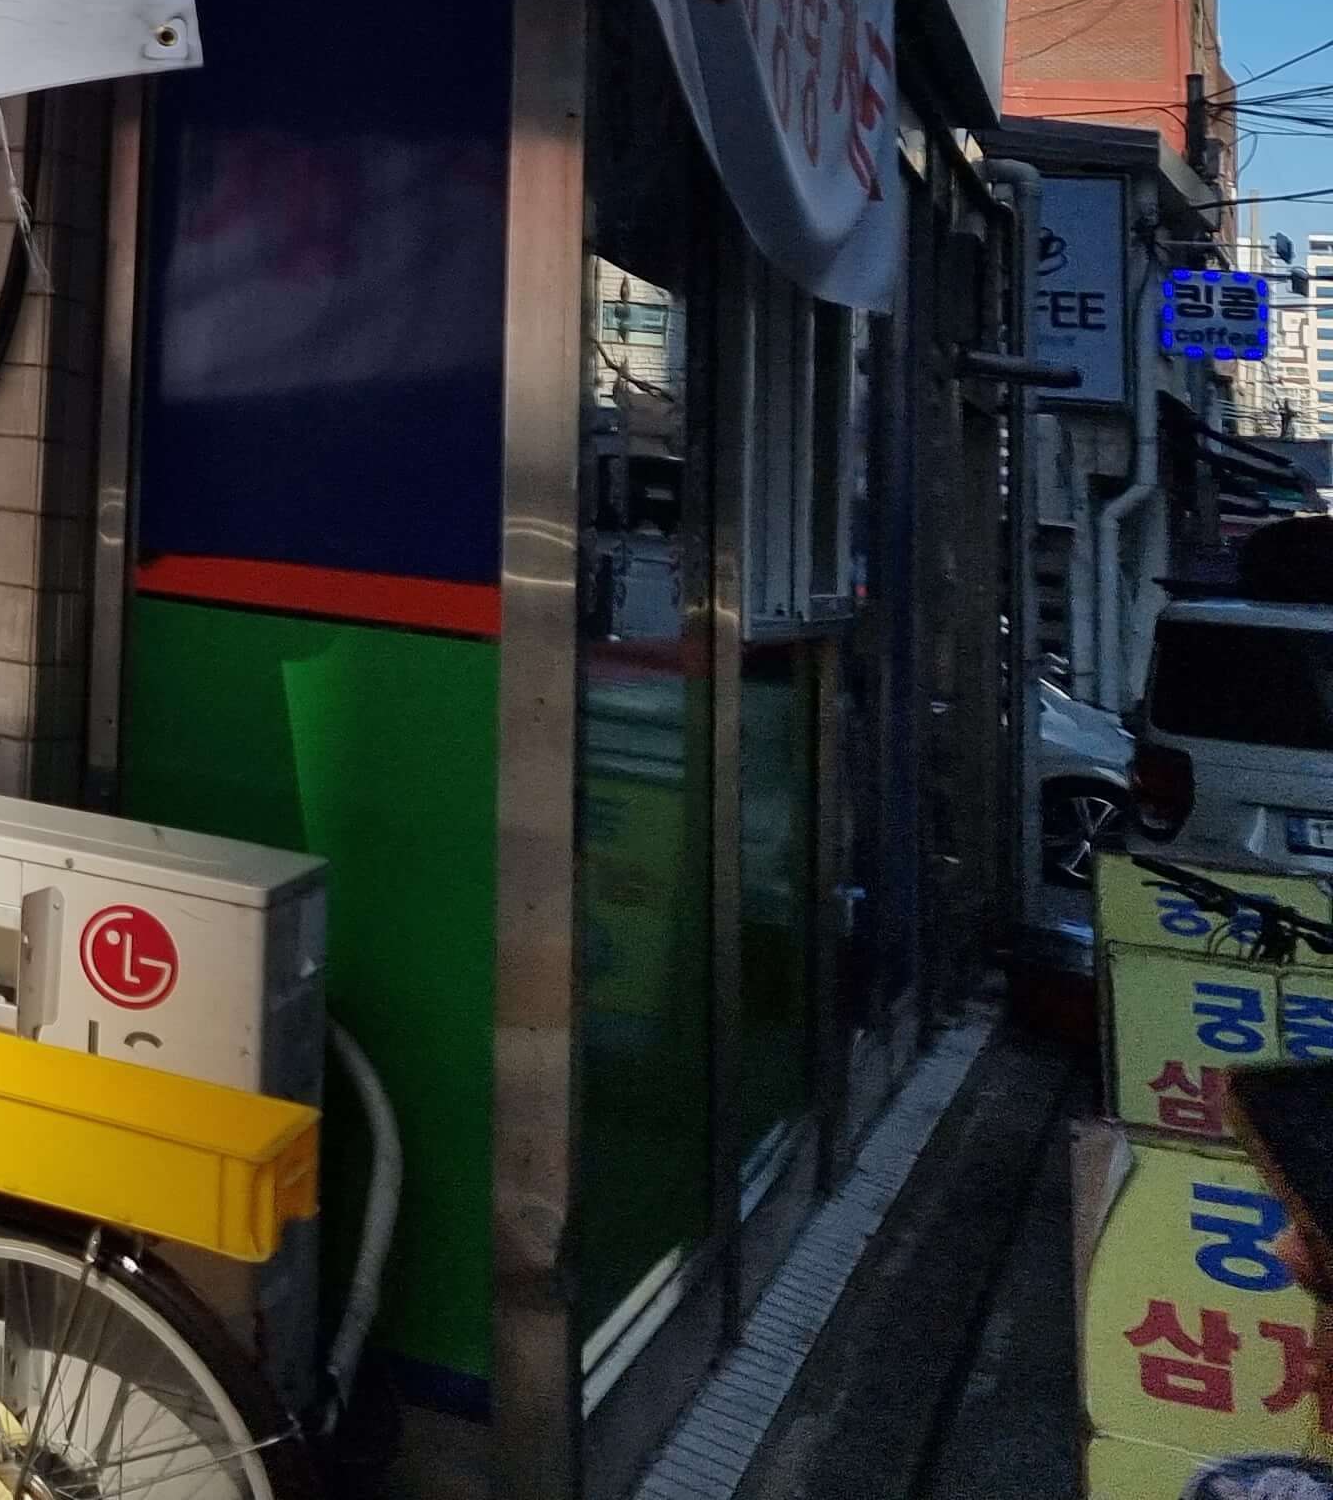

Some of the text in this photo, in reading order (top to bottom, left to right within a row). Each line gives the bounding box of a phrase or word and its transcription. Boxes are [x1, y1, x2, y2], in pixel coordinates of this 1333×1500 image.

[1175, 284, 1258, 320] 킹콩
[1175, 326, 1259, 345] coffee
[83, 908, 176, 1007] LG
